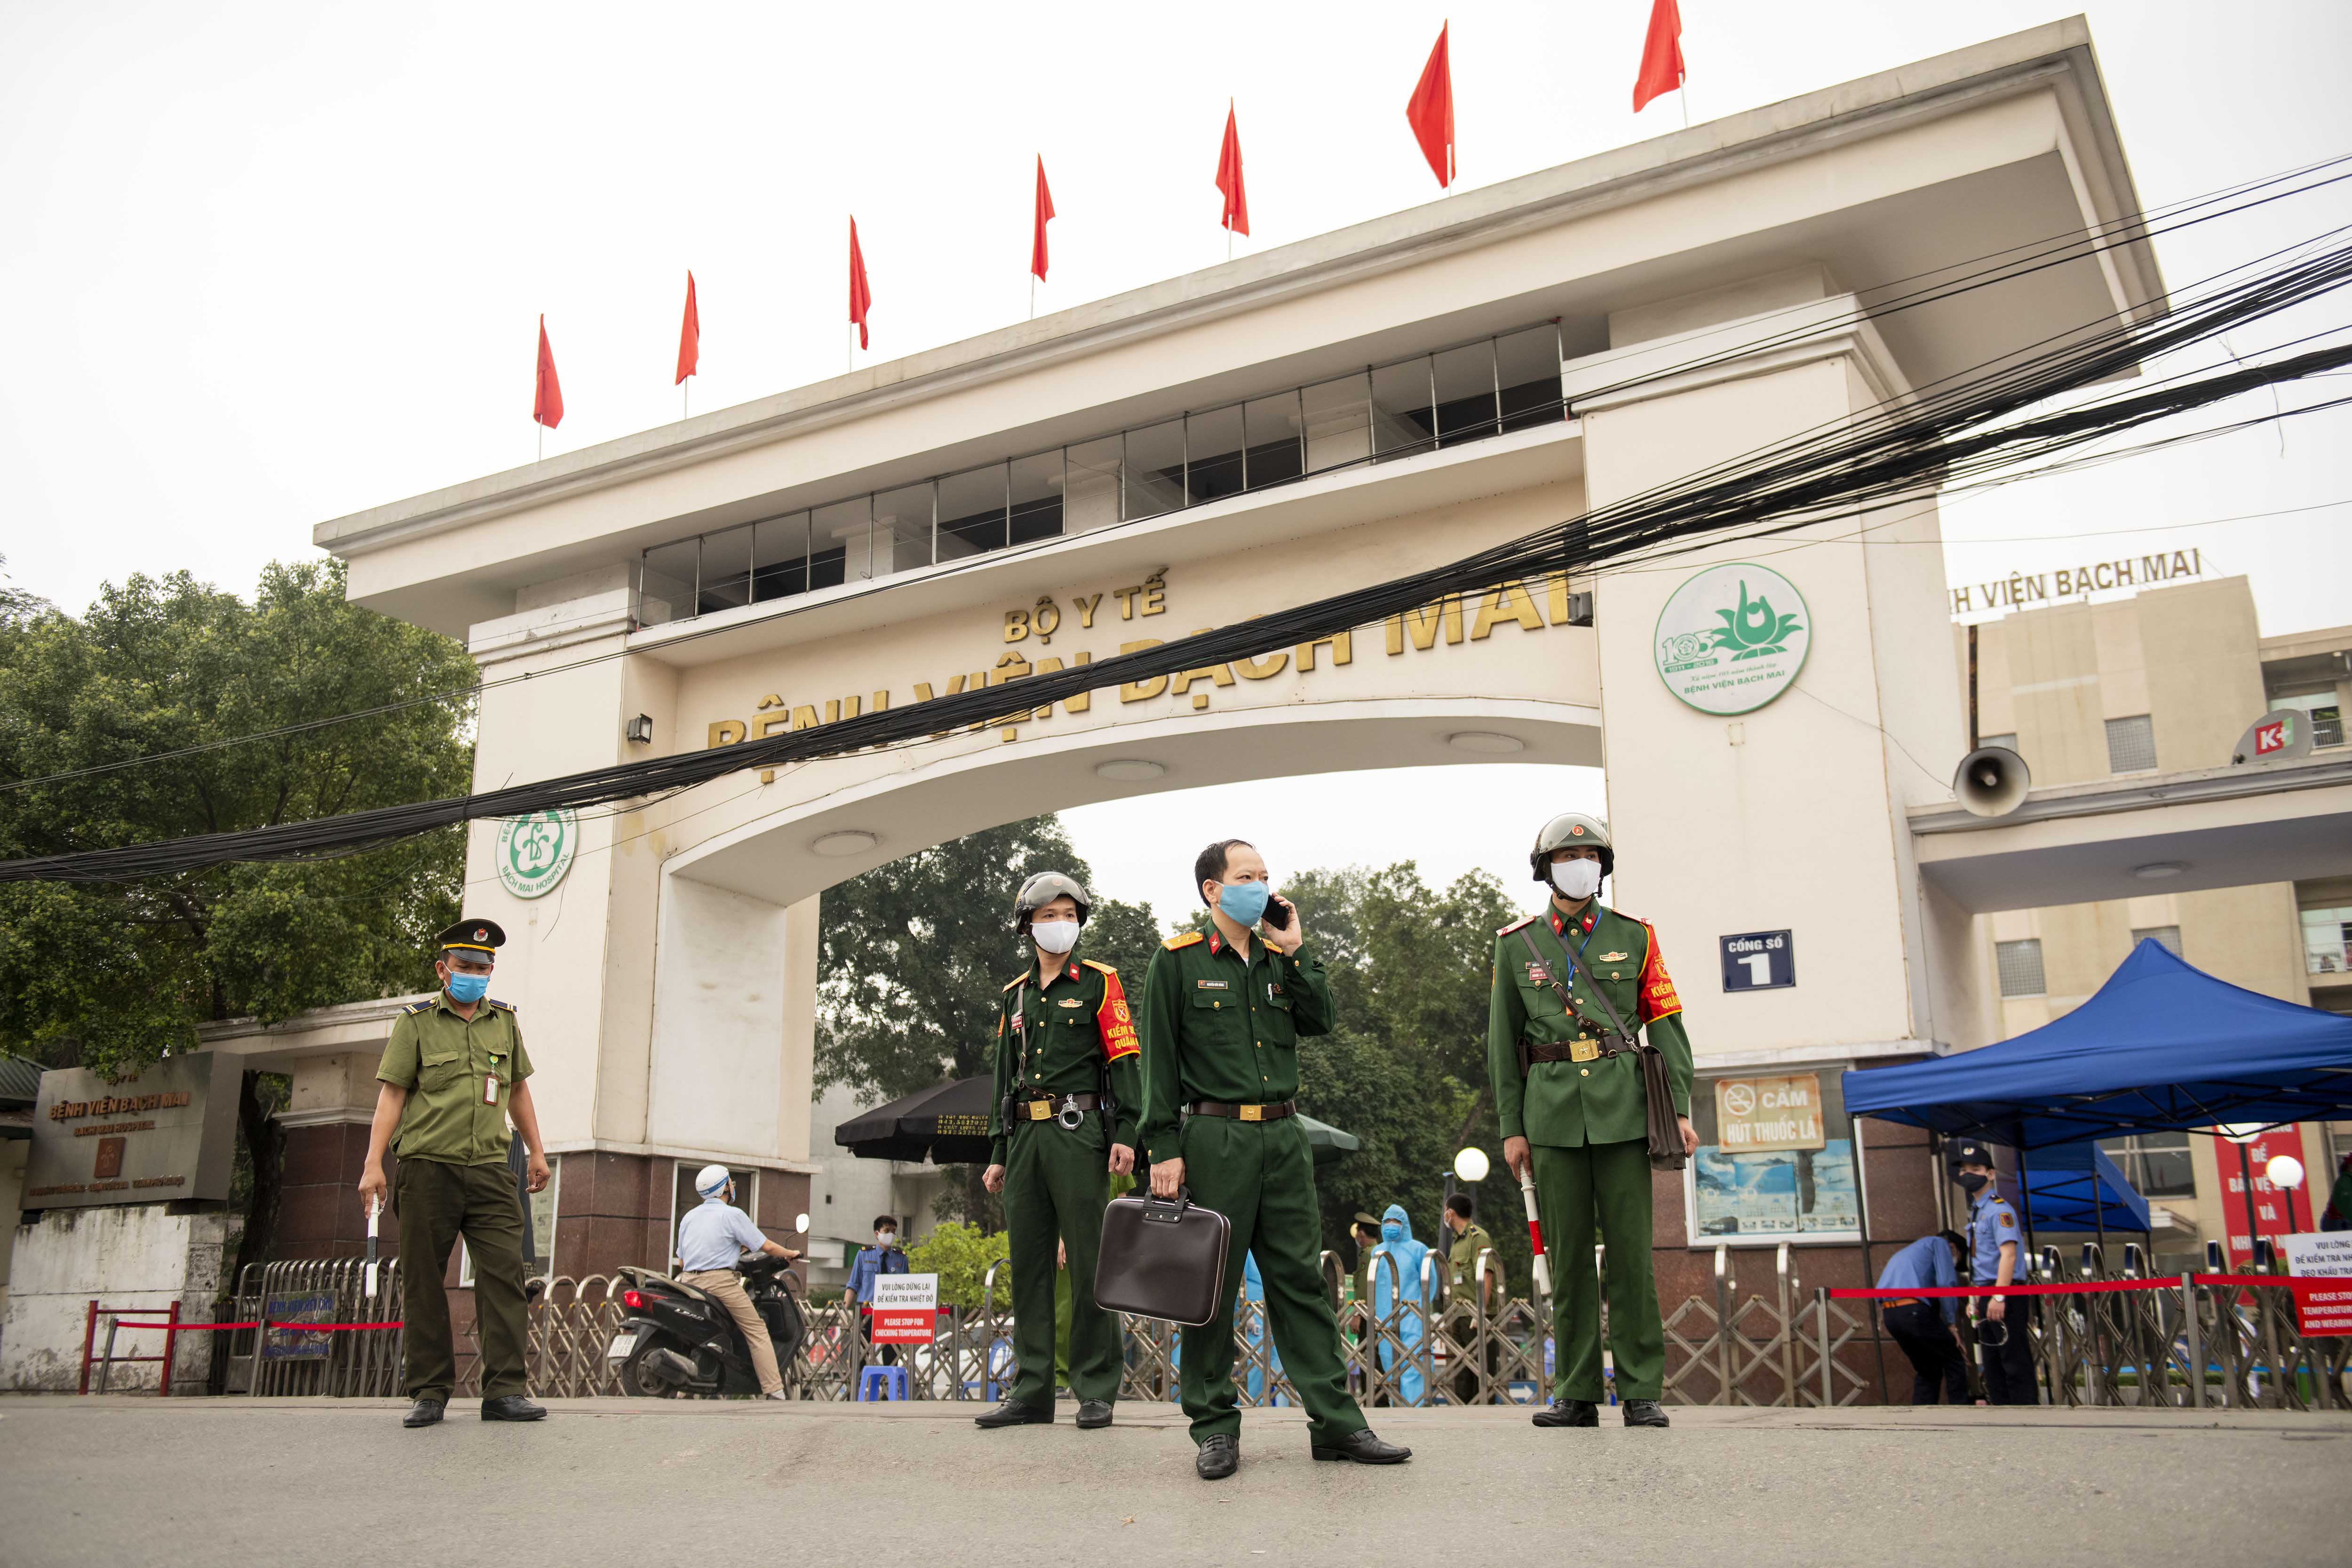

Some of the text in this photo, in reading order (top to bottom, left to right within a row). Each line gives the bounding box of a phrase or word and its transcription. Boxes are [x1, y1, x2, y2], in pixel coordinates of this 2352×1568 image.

[1981, 571, 2045, 612] VIỆN
[2055, 560, 2134, 600] BẠCH
[2143, 548, 2201, 582] MAI
[1004, 567, 1169, 645] BỘ Y TẾ
[1385, 569, 1568, 655] MAI
[1684, 670, 1786, 695] BỆNH VIỆN BẠCH MAI
[502, 852, 570, 892] BACH MAI HOSPITAL
[1765, 934, 1783, 949] SỐ
[1738, 953, 1771, 986] 1
[1762, 1084, 1807, 1108] CẤM
[49, 1091, 189, 1124] BỆNH VIỆN BẠCH MAI
[1727, 1114, 1817, 1143] HÚT THUỐC LÁ
[2229, 1171, 2253, 1193] BẢ
[2258, 1202, 2278, 1220] VÀ
[2315, 1239, 2350, 1250] VUI LÒNG
[2295, 1253, 2305, 1264] ĐỂ
[2306, 1252, 2325, 1264] KIỂM
[2317, 1266, 2337, 1276] KHẨU
[891, 1282, 905, 1291] LÒNG
[906, 1281, 921, 1290] DỪNG
[2309, 1292, 2336, 1302] PLEASE
[878, 1293, 885, 1303] ĐỂ
[885, 1292, 898, 1303] KIỂM
[909, 1293, 925, 1305] NHIỆT
[926, 1293, 933, 1305] ĐỘ
[2304, 1320, 2320, 1329] AND
